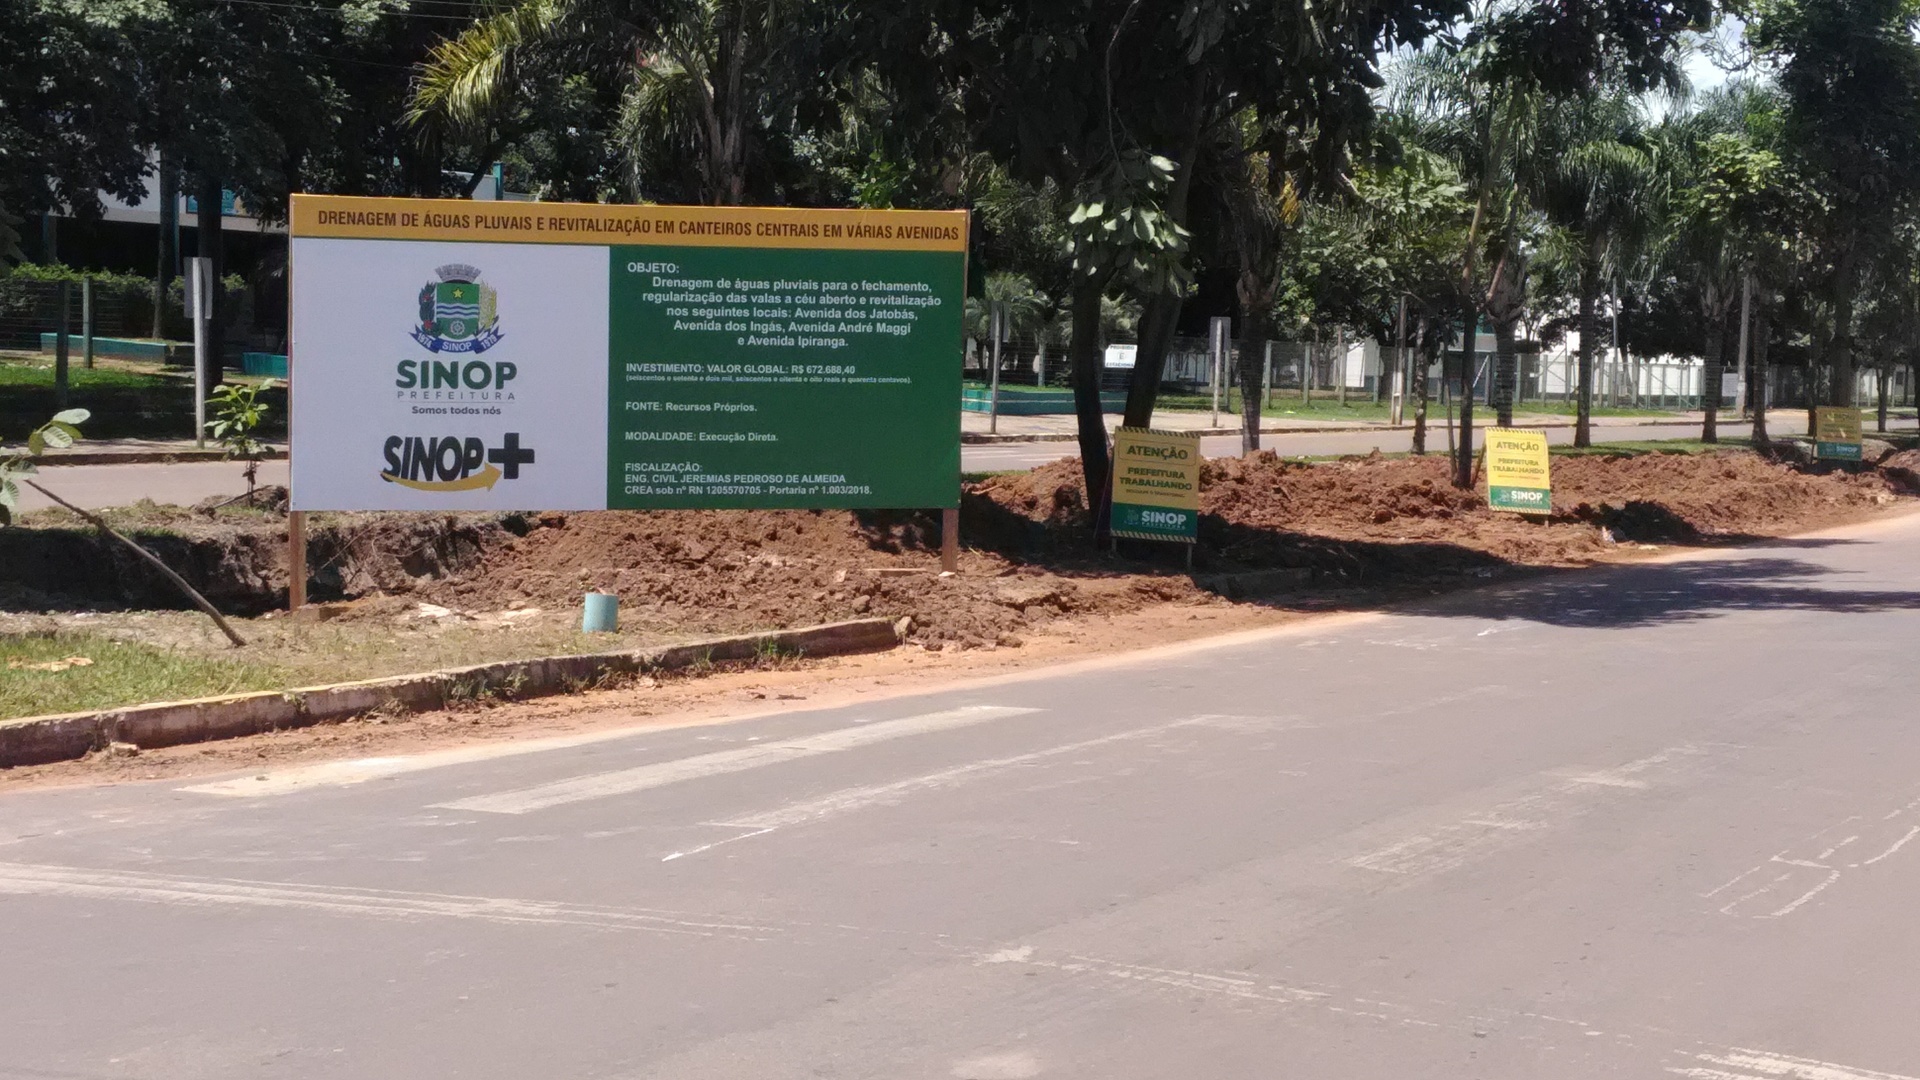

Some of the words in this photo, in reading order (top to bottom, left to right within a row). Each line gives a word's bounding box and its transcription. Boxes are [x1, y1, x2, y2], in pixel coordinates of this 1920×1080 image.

[319, 211, 396, 227] DRENAGEM
[402, 213, 419, 227] DE
[424, 211, 469, 229] ÁGUAS
[475, 215, 532, 230] PLUVAIS
[537, 217, 544, 230] E
[549, 216, 650, 237] REVITALIZAÇÃO
[655, 220, 674, 234] EM
[679, 221, 752, 236] CANTEIROS
[757, 223, 818, 237] CENTRAIS
[824, 224, 841, 238] EM
[847, 222, 892, 239] VÁRIAS
[897, 226, 959, 240] AVENIDAS
[628, 263, 679, 274] OBJETO:
[653, 277, 713, 291] Drenagem
[717, 278, 731, 289] de
[735, 278, 770, 292] águas
[774, 280, 818, 293] pluviais
[822, 282, 847, 293] para
[851, 282, 859, 291] o
[862, 280, 931, 293] fechamento,
[643, 292, 723, 306] regularização
[727, 293, 747, 304] das
[751, 293, 781, 304] valas
[785, 296, 792, 304] a
[795, 294, 816, 304] céu
[820, 294, 856, 305] aberto
[870, 295, 941, 308] revitalização
[667, 307, 688, 317] nos
[693, 306, 749, 320] seguintes
[754, 307, 791, 318] locais:
[795, 307, 841, 319] Avenida
[845, 308, 866, 319] dos
[870, 307, 918, 321] Jatobás,
[674, 320, 722, 331] Avenida
[725, 321, 747, 332] dos
[751, 321, 785, 335] Ingás,
[788, 322, 835, 333] Avenida
[839, 321, 873, 333] André
[877, 322, 911, 335] Maggi
[417, 333, 431, 348] 1974
[481, 335, 497, 349] 1979
[738, 337, 744, 345] e
[748, 335, 794, 346] Avenida
[799, 336, 848, 350] Ipiranga.
[442, 342, 472, 351] SINOP
[626, 364, 704, 372] INVESTIMENTO:
[707, 364, 741, 373] VALOR
[744, 365, 788, 374] GLOBAL:
[792, 365, 804, 374] R$
[806, 366, 855, 374] 672.688,40
[396, 360, 517, 390] SINOP
[398, 391, 515, 400] PREFEITURA
[412, 406, 447, 414] Somos
[451, 406, 479, 414] todos
[483, 406, 501, 415] nós
[626, 402, 662, 410] FONTE:
[666, 402, 711, 411] Recursos
[714, 403, 757, 413] Próprios.
[625, 432, 696, 441] MODALIDADE:
[699, 432, 745, 443] Execução
[749, 433, 778, 441] Direta.
[1496, 441, 1539, 452] ATENÇÃO
[1127, 446, 1188, 460] ATENÇÃO
[625, 462, 702, 473] FISCALIZAÇÃO:
[1128, 467, 1185, 479] PREFEITURA
[1493, 466, 1544, 474] TRABALHANDO
[625, 474, 649, 483] ENG.
[652, 475, 677, 483] CIVIL
[681, 475, 731, 483] JEREMIAS
[734, 475, 783, 484] PEDROSO
[786, 475, 799, 483] DE
[802, 475, 846, 483] ALMEIDA
[1120, 477, 1192, 490] TRABALHANDO
[625, 486, 653, 494] CREA
[656, 486, 673, 494] sob
[689, 486, 703, 494] RN
[706, 486, 760, 494] 1205570705
[770, 486, 806, 494] Portaria
[822, 486, 872, 494] 1.003/2018.
[1511, 491, 1543, 500] SINOP
[1142, 511, 1186, 524] SINOP
